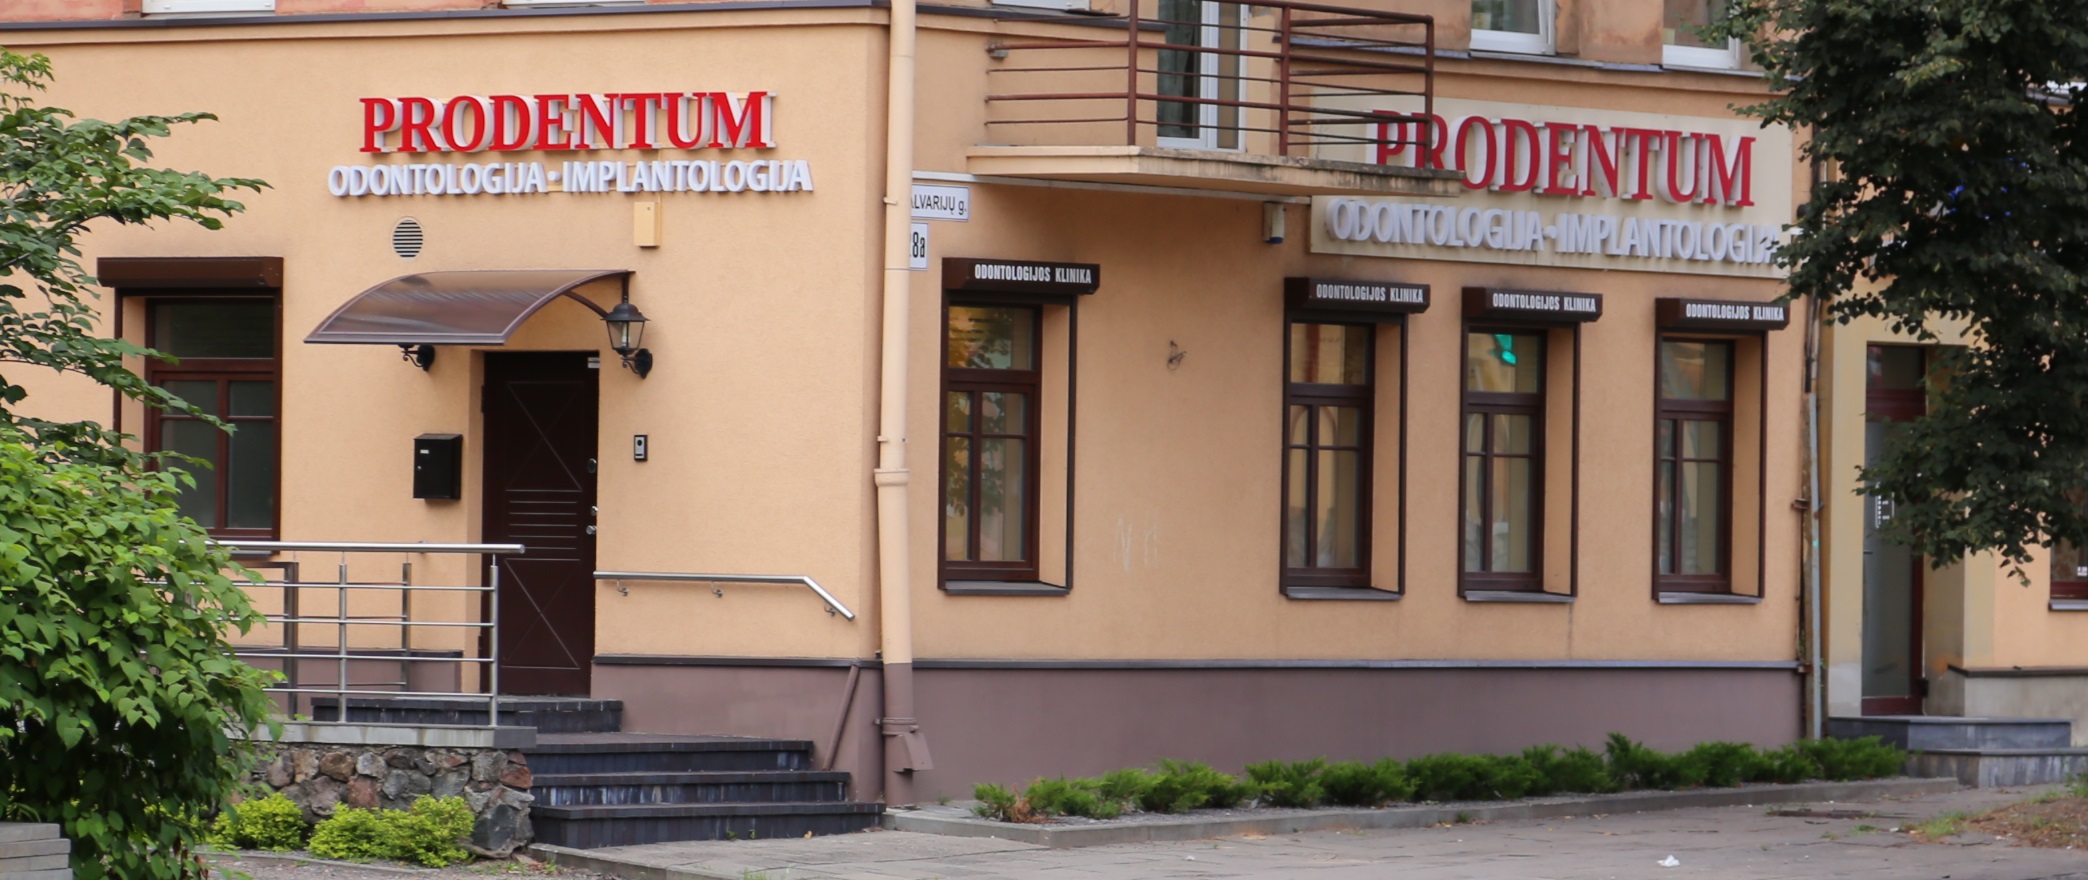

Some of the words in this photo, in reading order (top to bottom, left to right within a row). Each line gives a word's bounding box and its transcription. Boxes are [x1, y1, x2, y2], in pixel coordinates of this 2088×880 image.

[359, 91, 777, 152] PRODENTUM
[1367, 109, 1756, 207] PRODENTUM
[328, 162, 548, 197] ODONTOLOGIJA
[562, 160, 813, 193] IMPLANTOLOGIJA
[911, 194, 956, 215] LVARIJŲ
[910, 231, 925, 258] 8a
[974, 264, 1051, 282] ODONTOLOGIJOS
[1055, 267, 1092, 284] KLINIKA
[1316, 284, 1386, 301] ODONTOLOGIJOS
[1389, 287, 1424, 303] KLINIKA
[1492, 293, 1560, 310] ODONTOLOGIJOS
[1563, 296, 1597, 312] KLINIKA
[1685, 303, 1750, 320] ODONTOLOGIJOS
[1752, 306, 1785, 321] KLINIKA
